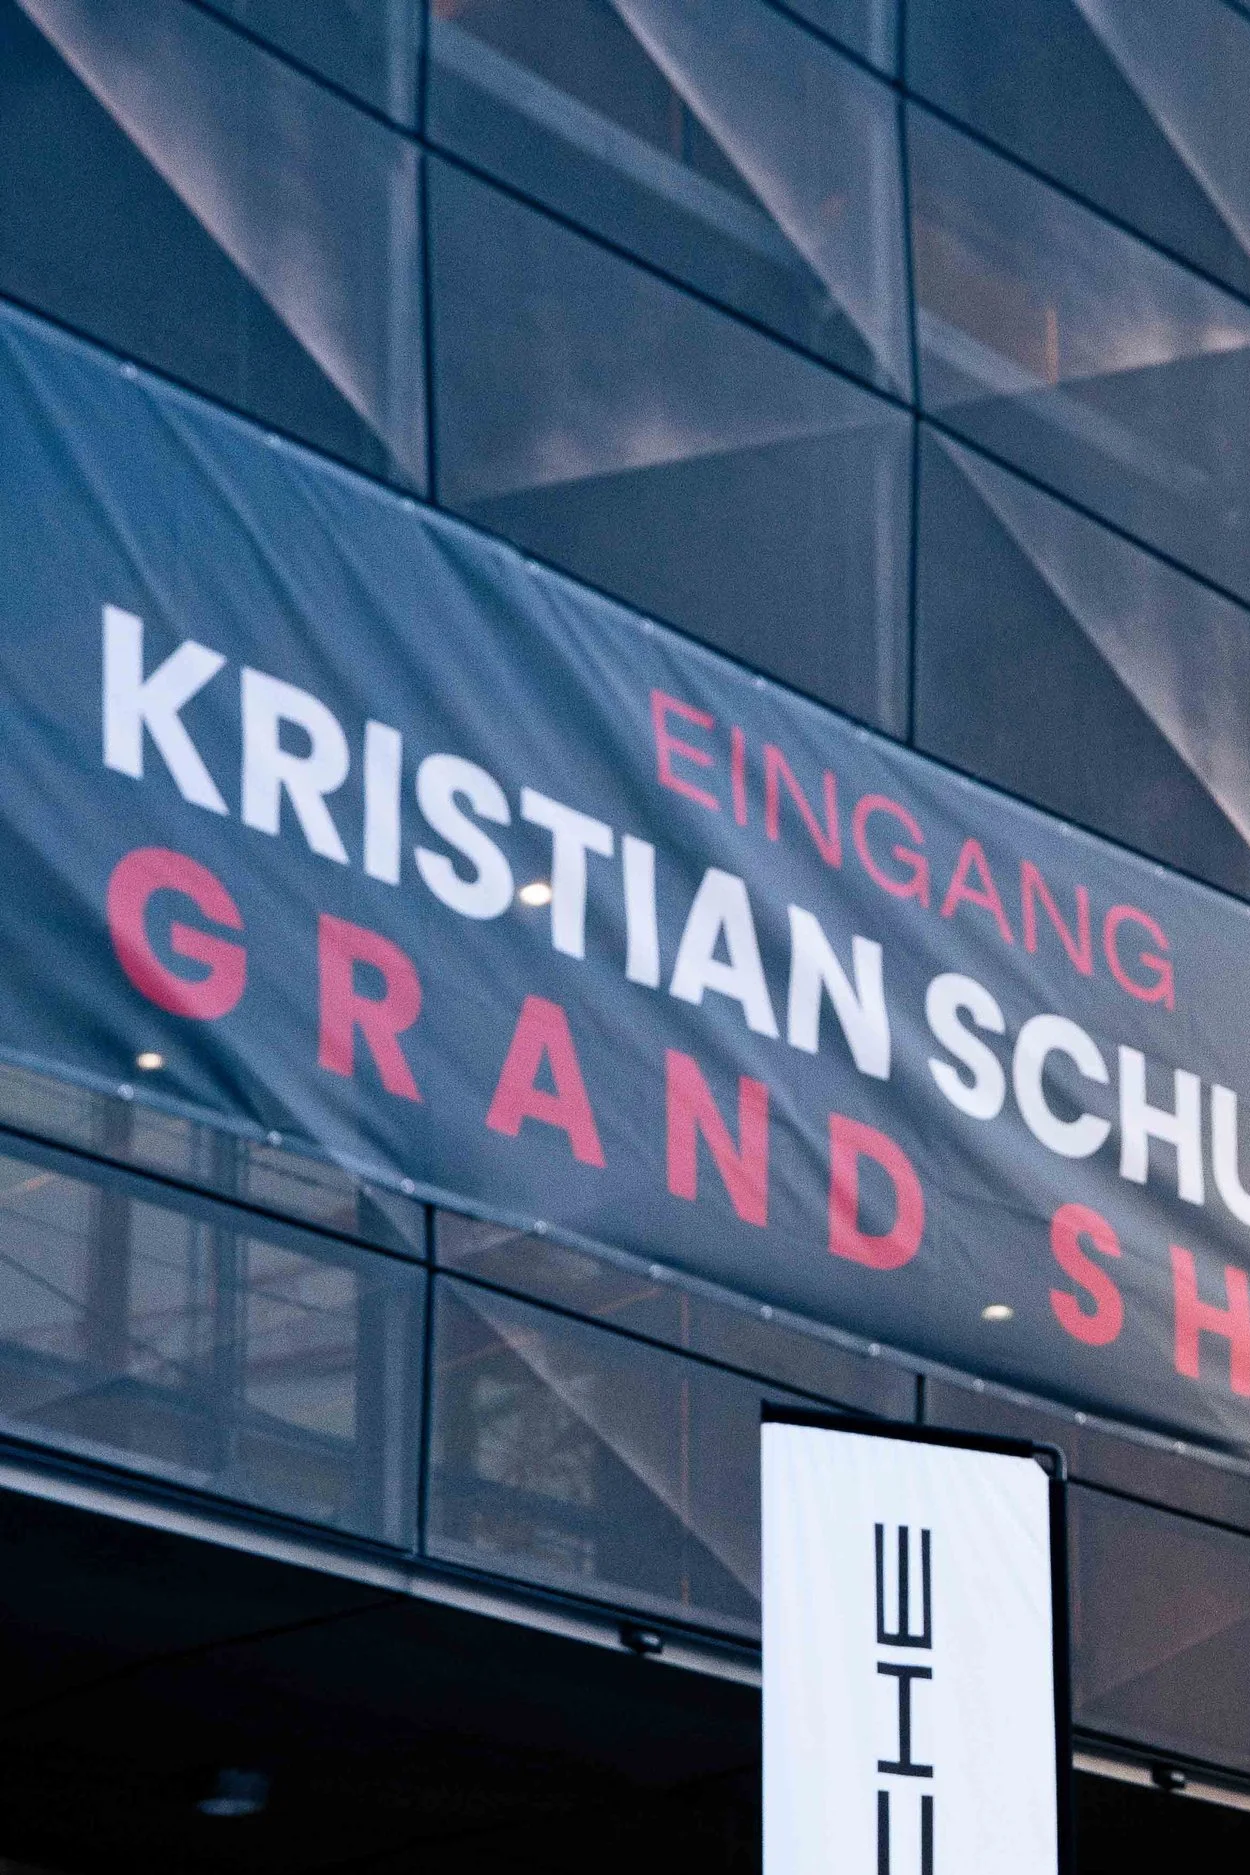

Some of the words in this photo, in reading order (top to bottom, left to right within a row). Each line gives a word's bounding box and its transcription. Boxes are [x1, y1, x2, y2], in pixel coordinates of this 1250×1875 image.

[102, 604, 893, 1081] KRISTIAN
[651, 690, 1175, 1010] EINGANG
[106, 846, 926, 1271] GRAND
